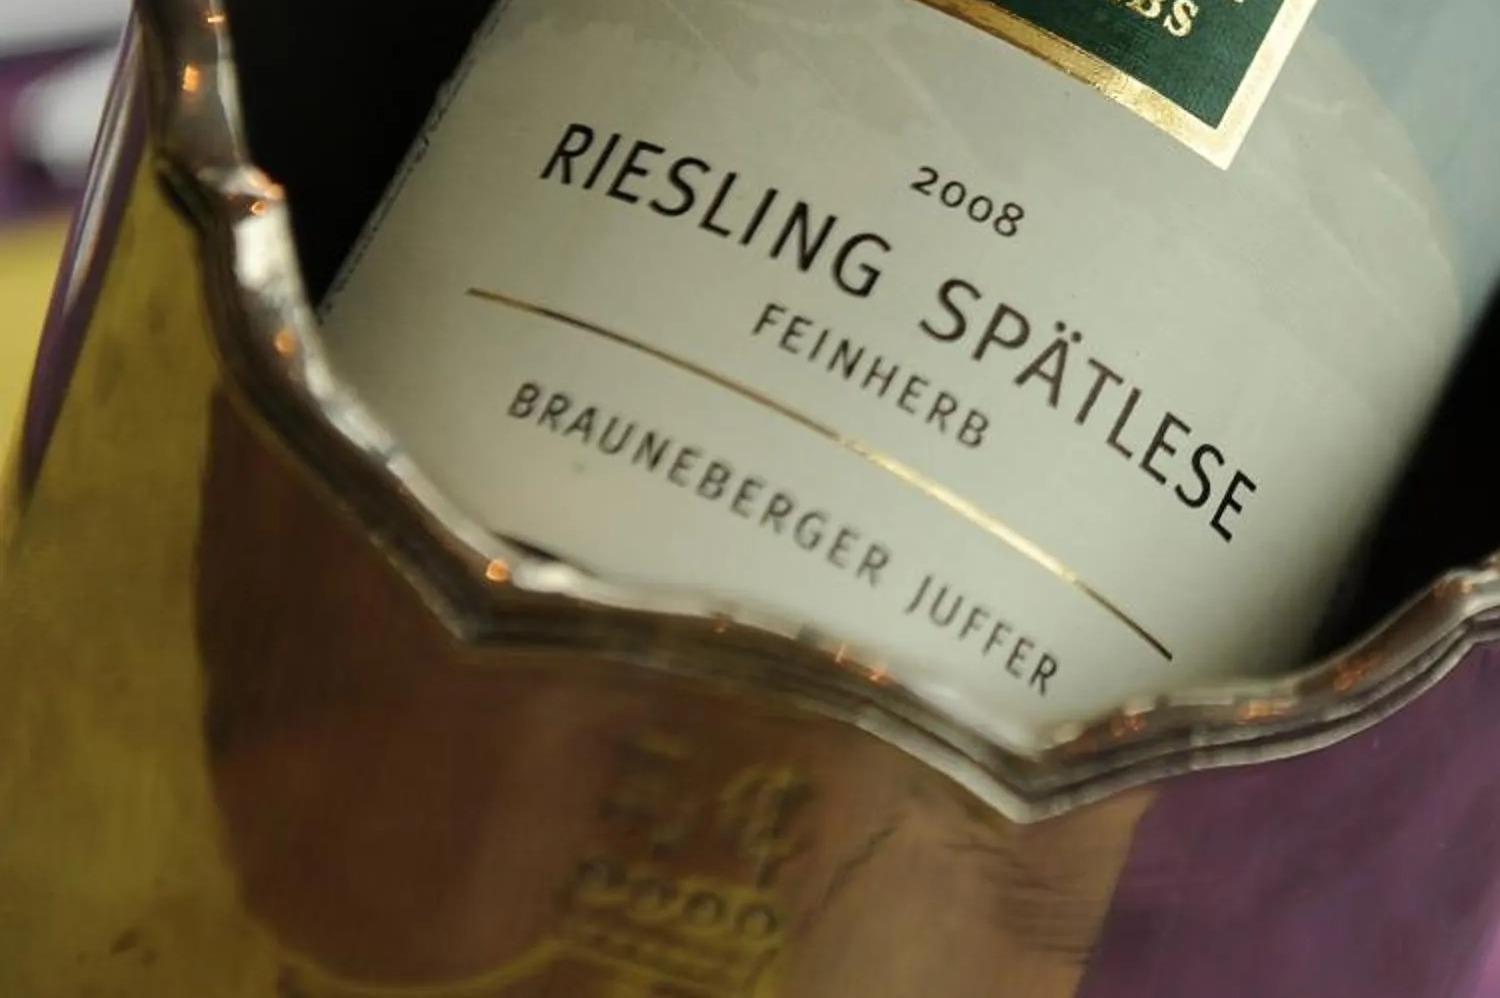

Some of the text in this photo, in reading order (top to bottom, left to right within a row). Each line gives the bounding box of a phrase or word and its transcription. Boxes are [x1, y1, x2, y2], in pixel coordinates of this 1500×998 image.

[910, 166, 1026, 238] 2008
[540, 123, 893, 298] RIESLING
[919, 277, 1257, 543] SPÄTLESE
[751, 303, 990, 450] FEINHERB
[506, 382, 1058, 696] BRAUNEBERGER JUFFER
